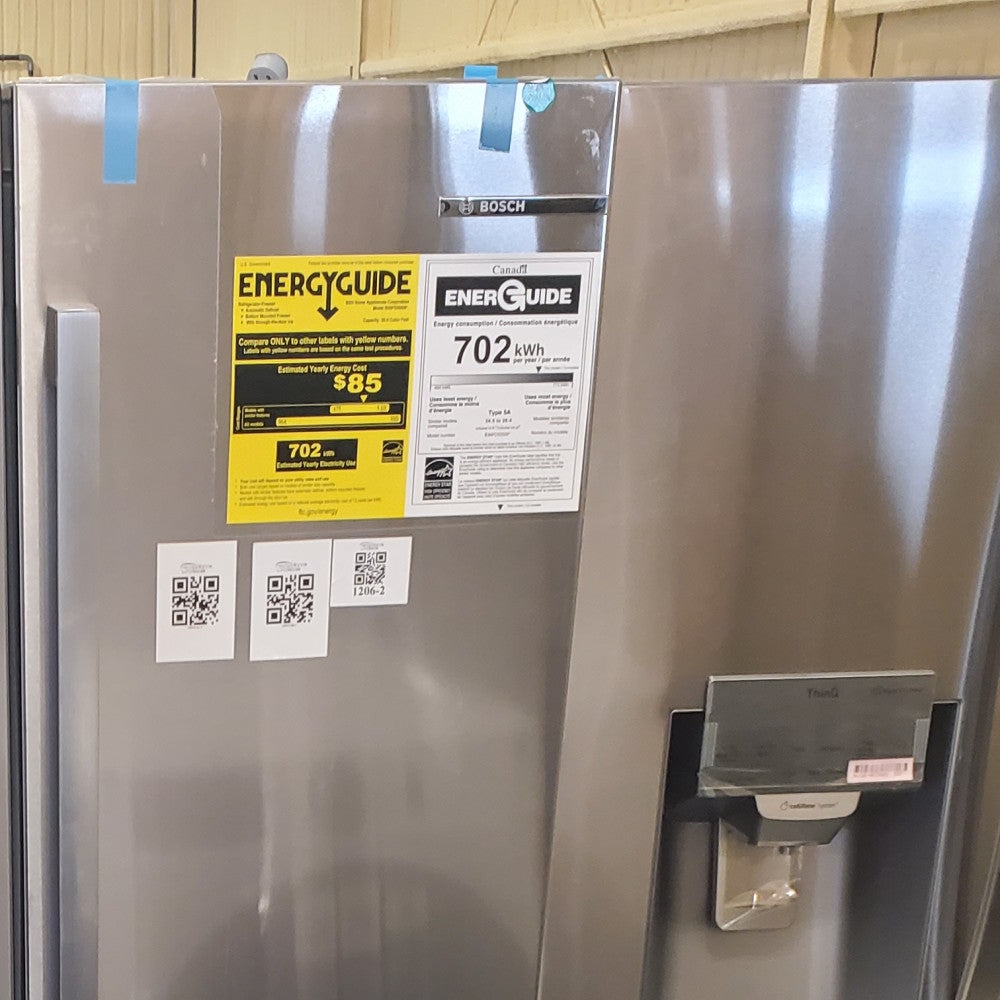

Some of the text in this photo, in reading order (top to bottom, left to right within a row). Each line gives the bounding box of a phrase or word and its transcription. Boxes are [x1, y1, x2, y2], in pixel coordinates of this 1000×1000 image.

[479, 199, 526, 213] BOSCH
[492, 264, 528, 275] Canada
[238, 270, 412, 298] ENERGYGUIDE
[444, 279, 573, 312] ENERGUIDE
[433, 321, 454, 329] Energy
[455, 320, 494, 328] consumption
[499, 319, 542, 327] Consommation
[543, 319, 579, 328] énergétique
[238, 335, 409, 347] Compare ONLY to other labels with yellow numbers.
[454, 335, 545, 364] 702 kWh
[277, 364, 367, 374] Estimated Yearly Energy Cost
[333, 373, 382, 394] $85
[288, 443, 322, 459] 702
[276, 461, 302, 469] Estimated
[303, 461, 320, 469] Yearly
[320, 460, 346, 468] Electricity
[352, 586, 386, 597] 1206-2
